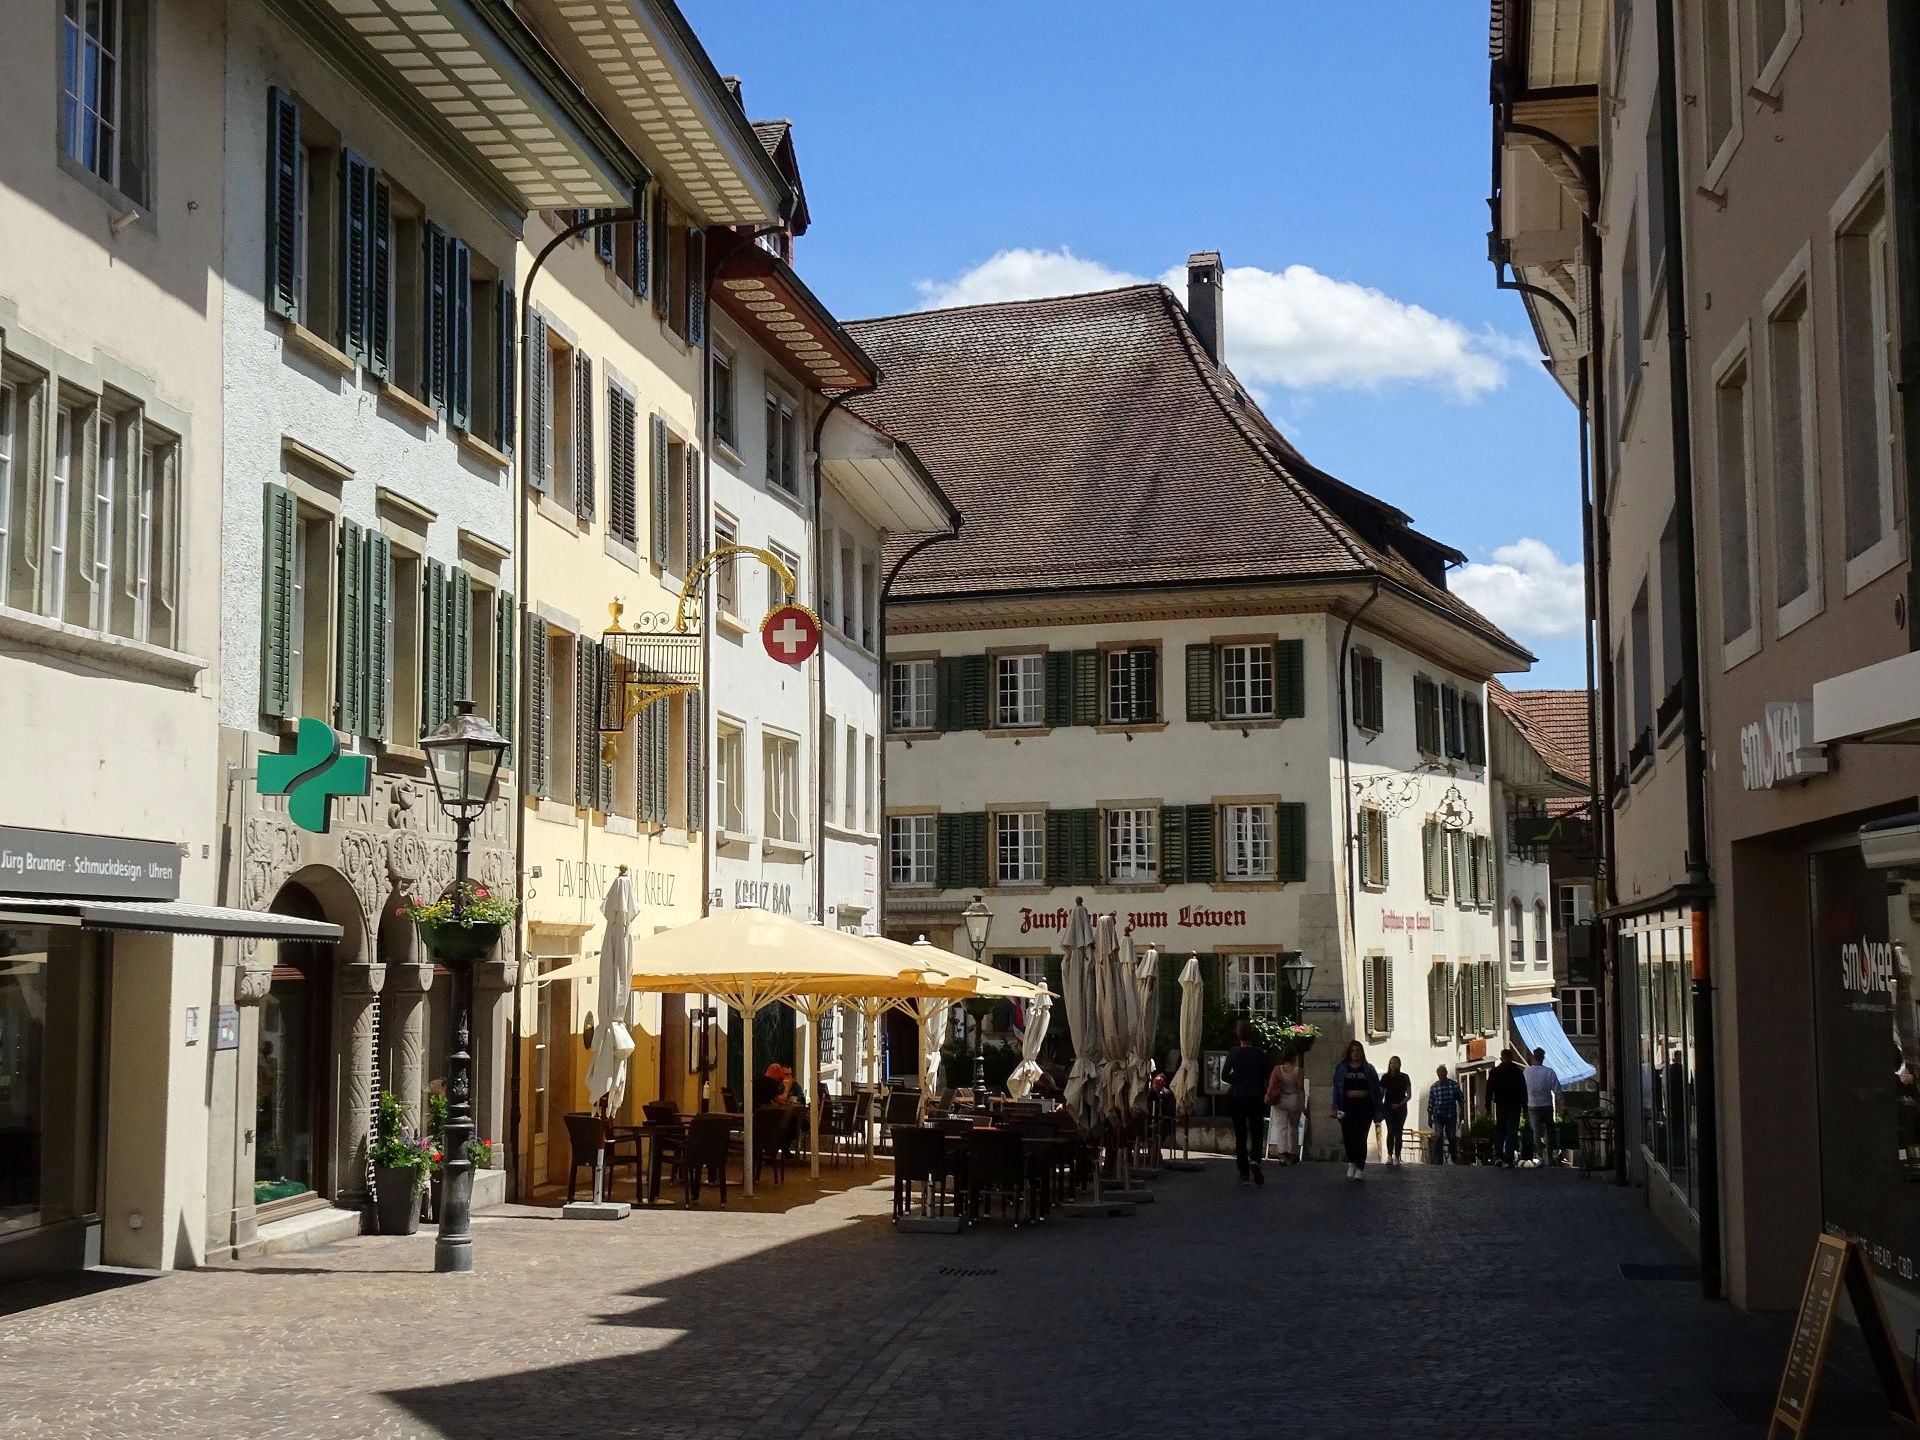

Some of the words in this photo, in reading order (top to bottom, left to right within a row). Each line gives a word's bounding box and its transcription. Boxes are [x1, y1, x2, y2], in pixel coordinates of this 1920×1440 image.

[1741, 703, 1801, 790] smokee
[1, 850, 24, 874] Jürg
[26, 852, 66, 872] Brunner
[74, 857, 142, 881] Schmuckdesign
[148, 862, 173, 880] Uhren
[556, 858, 607, 901] TAVERNE
[644, 870, 676, 907] KREUZ
[773, 883, 792, 916] BAR
[1127, 910, 1168, 932] zum
[1178, 905, 1247, 928] Löwen
[1842, 934, 1893, 995] smokee
